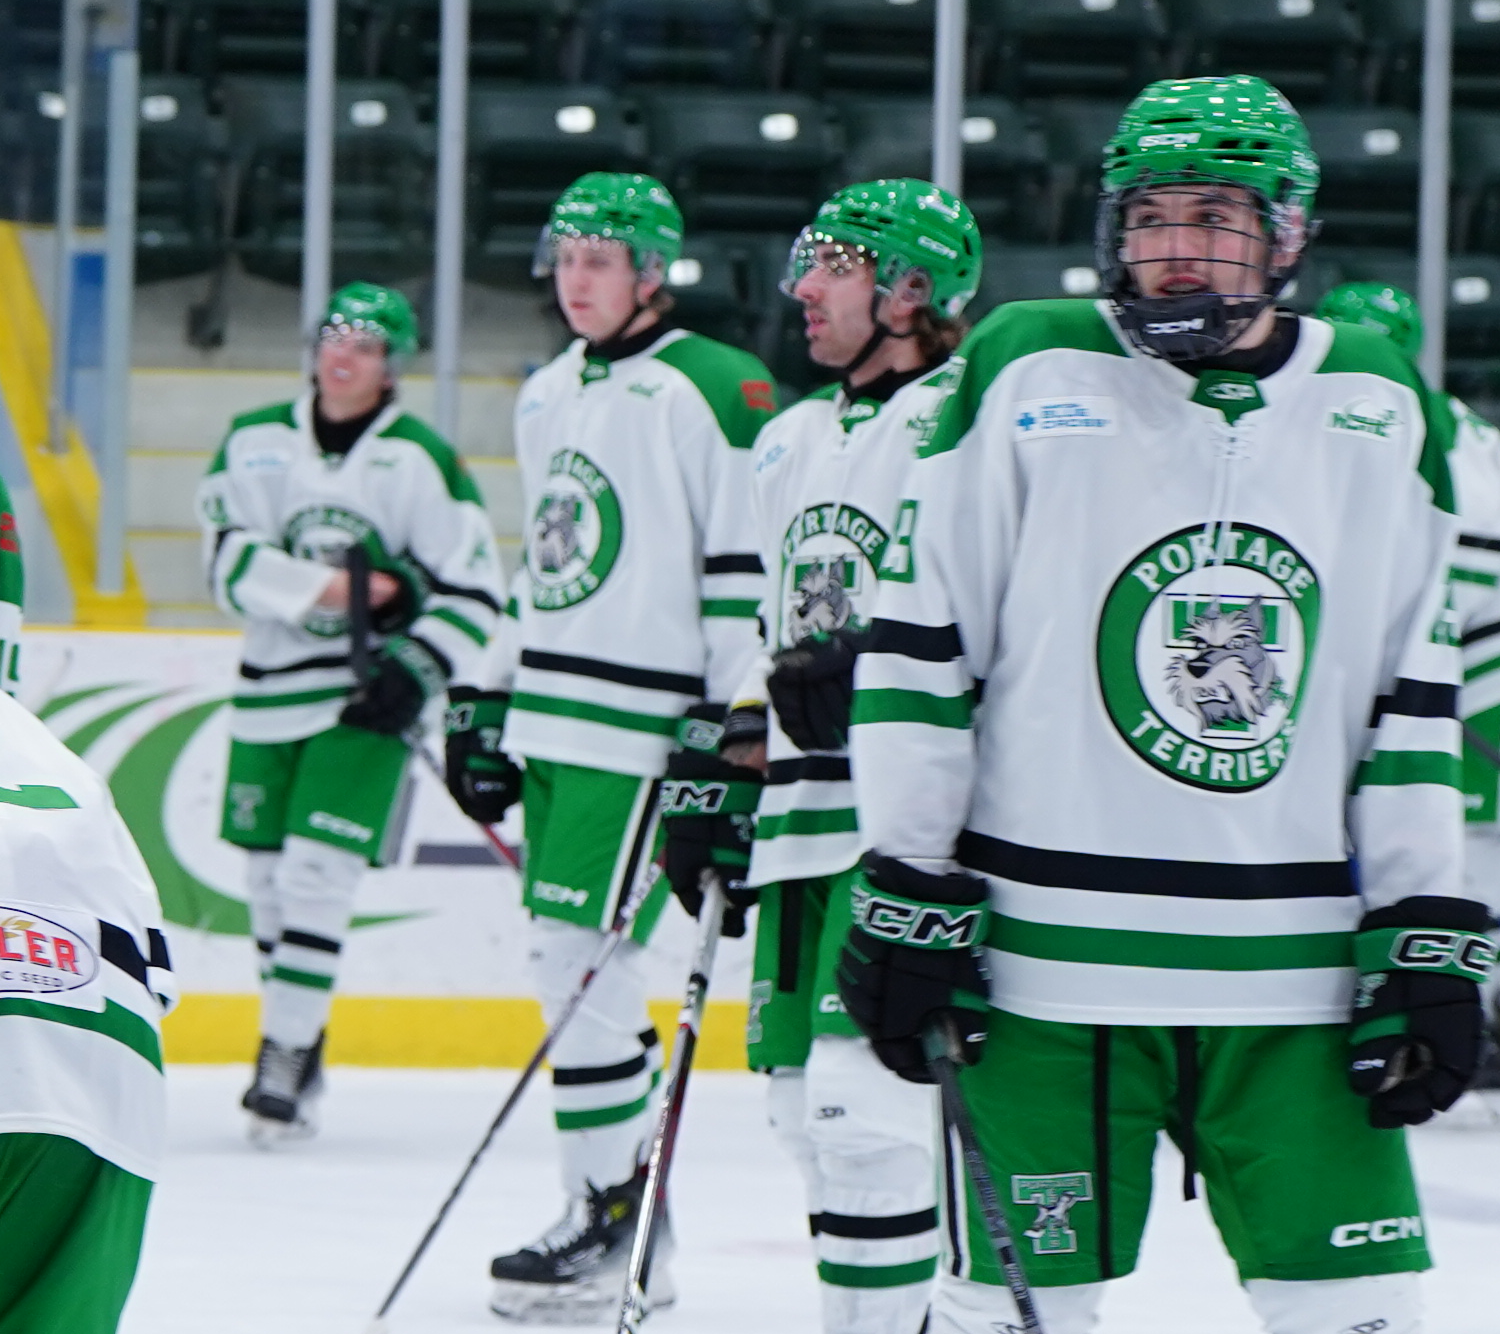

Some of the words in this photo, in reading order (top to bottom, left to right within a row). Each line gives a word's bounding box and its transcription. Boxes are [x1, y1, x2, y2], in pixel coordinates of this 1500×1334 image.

[1131, 530, 1316, 599] PORTAGE
[1388, 929, 1494, 983] CC
[22, 971, 66, 989] SEED
[1329, 1216, 1423, 1249] CCM
